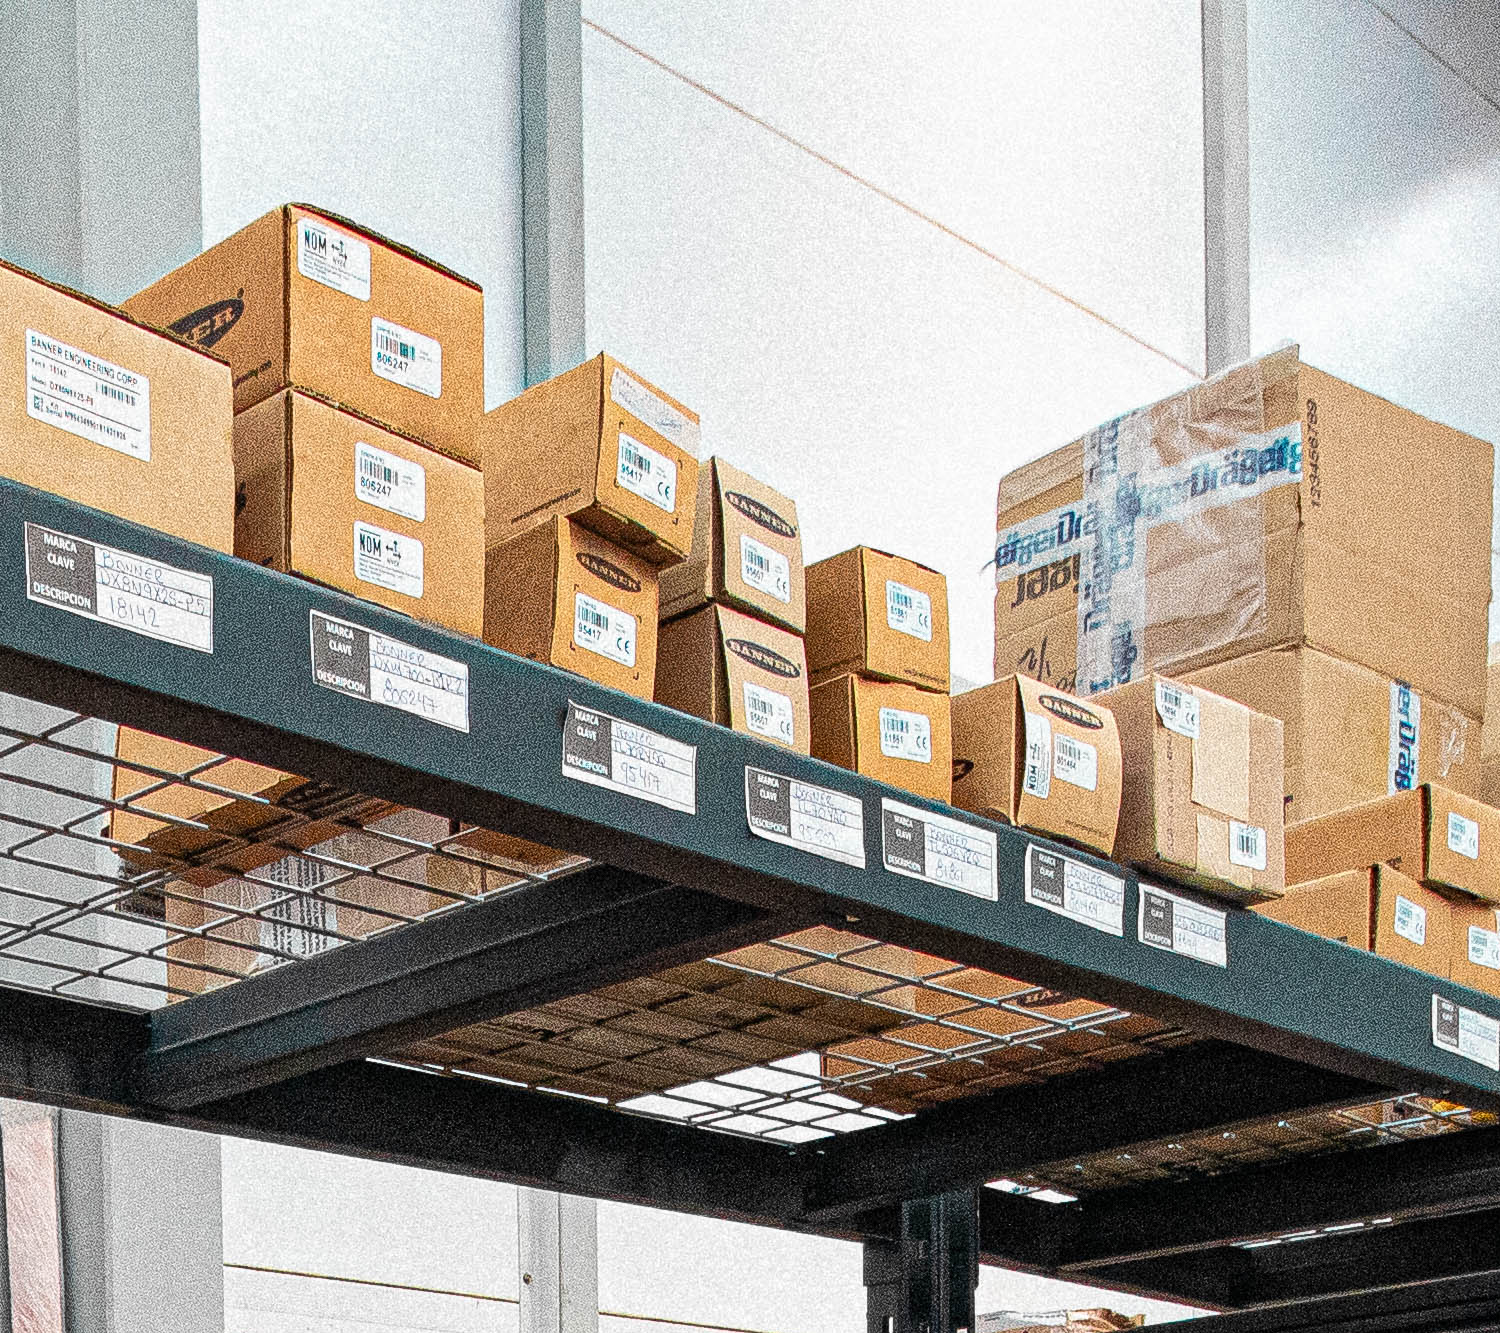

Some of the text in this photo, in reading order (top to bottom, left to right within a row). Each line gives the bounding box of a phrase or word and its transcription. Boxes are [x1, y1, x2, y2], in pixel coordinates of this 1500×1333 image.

[304, 230, 328, 251] NOM
[731, 495, 793, 536] BANNER
[43, 533, 77, 553] MARCA
[359, 533, 382, 556] NOM
[46, 551, 75, 571] CLAVE
[33, 581, 92, 608] DESCRIPCION
[326, 622, 355, 641] MARCA
[328, 639, 352, 656] CLAVE
[730, 642, 798, 677] BANNER
[317, 670, 367, 695] DESCRIPCION
